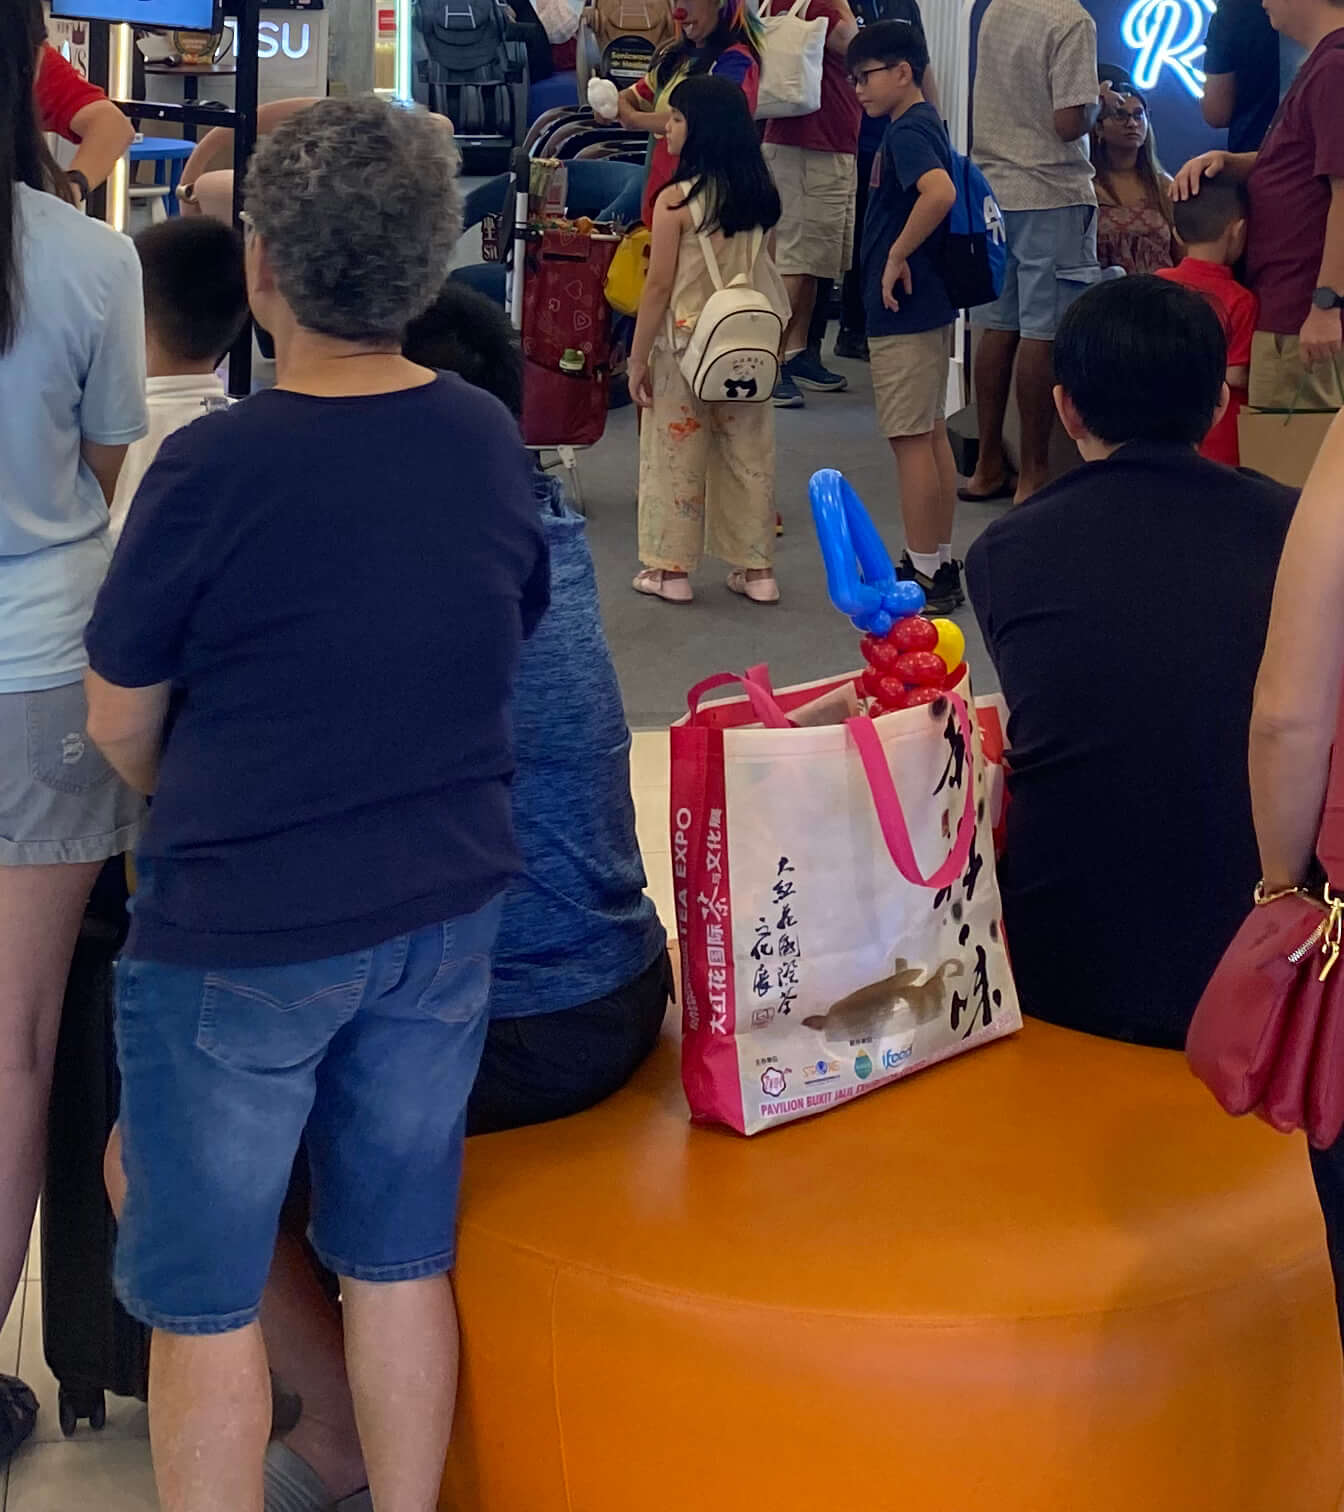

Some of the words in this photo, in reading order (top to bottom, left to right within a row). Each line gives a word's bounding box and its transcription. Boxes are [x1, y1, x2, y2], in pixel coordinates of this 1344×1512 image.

[215, 20, 310, 59] TSU
[674, 807, 692, 879] EXPO
[761, 1096, 805, 1118] PAVILION
[806, 1091, 832, 1108] BUKIT
